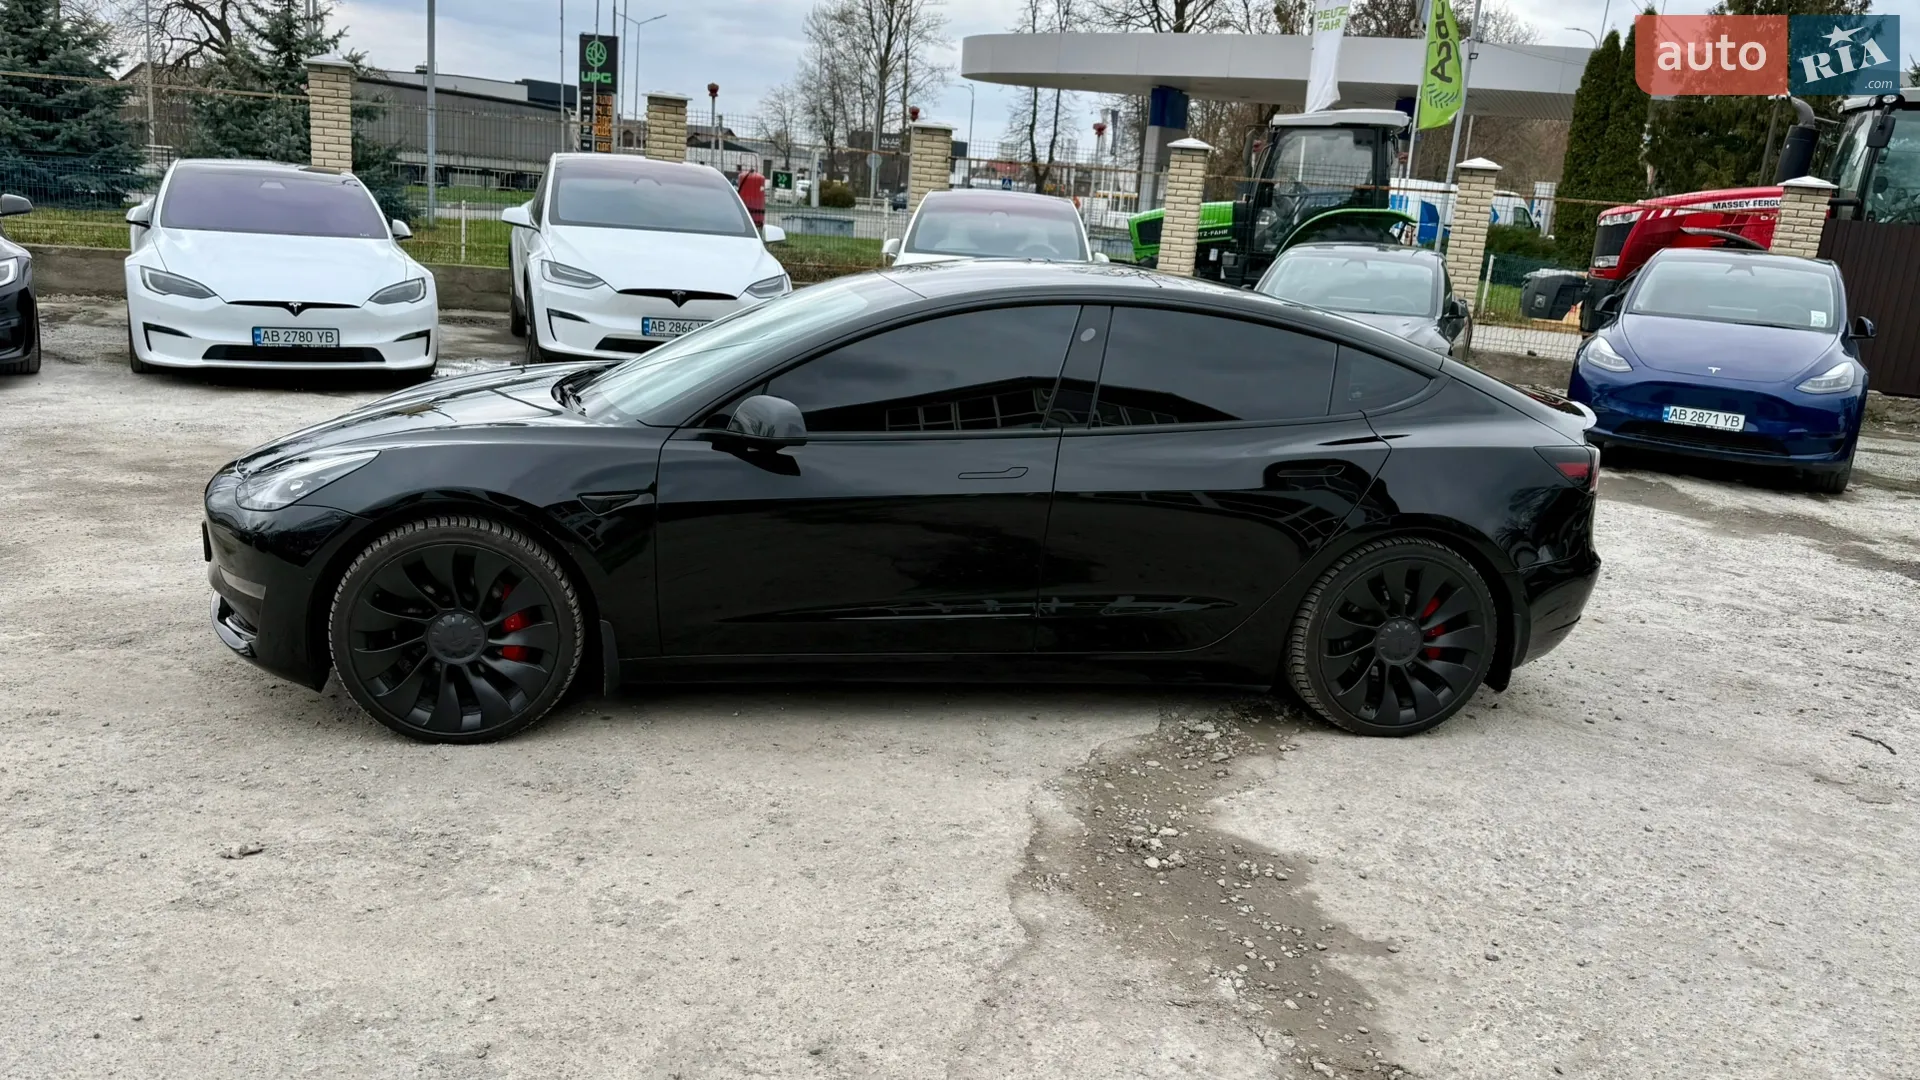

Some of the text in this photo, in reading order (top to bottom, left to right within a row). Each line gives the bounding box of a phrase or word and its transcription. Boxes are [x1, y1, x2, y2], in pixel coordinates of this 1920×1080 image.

[1317, 18, 1341, 31] FAHR
[581, 71, 612, 84] UPG
[1713, 199, 1782, 210] MASSEY FERGU
[1197, 229, 1228, 237] TZ-FAHR
[651, 321, 666, 332] AB
[669, 322, 694, 333] 2866
[263, 331, 335, 343] AB 2780 YB
[1670, 408, 1687, 420] AB
[1690, 411, 1719, 425] 2871
[1723, 414, 1740, 428] YB
